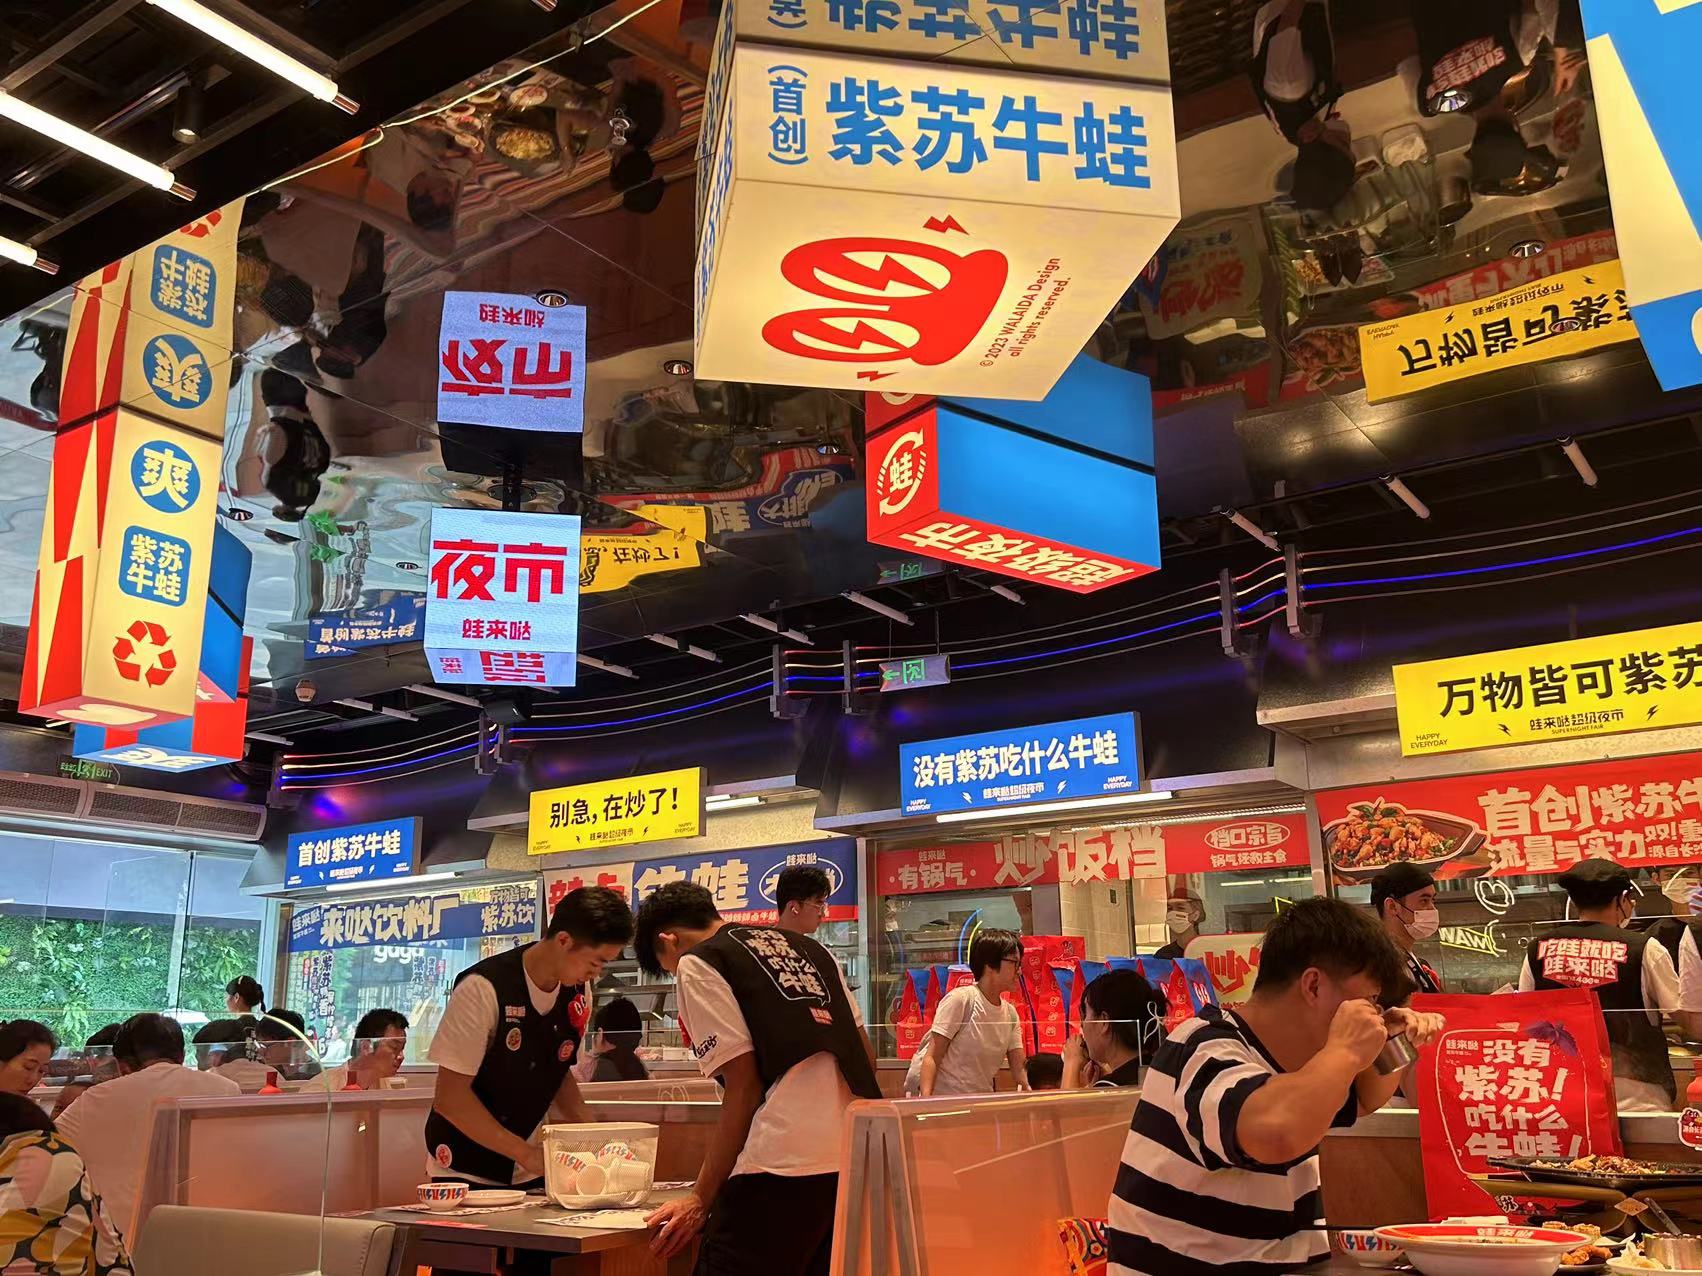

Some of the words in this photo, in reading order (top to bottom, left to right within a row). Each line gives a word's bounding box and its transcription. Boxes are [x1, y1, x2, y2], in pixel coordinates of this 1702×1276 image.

[826, 77, 1151, 189] 紫苏牛蛙
[985, 337, 1008, 359] 2023
[999, 294, 1038, 336] WALAIDA
[1027, 258, 1060, 291] Design
[1008, 347, 1024, 357] all
[1016, 321, 1040, 344] rights
[140, 447, 192, 509] 爽
[889, 451, 913, 493] 蛙
[130, 534, 185, 573] 紫苏
[898, 522, 1135, 587] 超级夜市
[126, 564, 182, 603] 牛蛙
[431, 538, 568, 603] 夜市
[462, 619, 532, 641] 蛙来哒
[1438, 643, 1702, 718] 万物皆可紫苏
[1530, 709, 1624, 731] 蛙来哒超级夜市
[1411, 738, 1448, 749] EVERYDAY
[1416, 732, 1440, 741] HAPPY
[913, 729, 1119, 788] 没有紫苏吃什么牛蛙
[96, 770, 113, 779] EXIT
[1103, 780, 1133, 790] EVERYDAY
[1107, 775, 1128, 783] HAPPY
[910, 798, 928, 806] HAPPY
[299, 829, 401, 867] 首创紫苏牛蛙
[1211, 824, 1283, 849] 档口宗旨
[786, 853, 817, 866] 蛙来哒
[919, 849, 946, 861] 蛙来哒
[994, 826, 1167, 888] 炒饭档
[1210, 849, 1287, 868] 锅气拯救主食
[1486, 829, 1646, 872] 流量与实力
[1537, 938, 1628, 963] 吃蛙就吃
[1543, 955, 1617, 979] 蛙来哒
[779, 971, 825, 996] 牛蛙
[1446, 1039, 1479, 1050] 蛙来哒
[1482, 1038, 1551, 1067] 没有
[1455, 1064, 1568, 1103] 紫苏！
[1464, 1103, 1568, 1131] 吃什么
[1476, 1228, 1534, 1238] 蛙来哒
